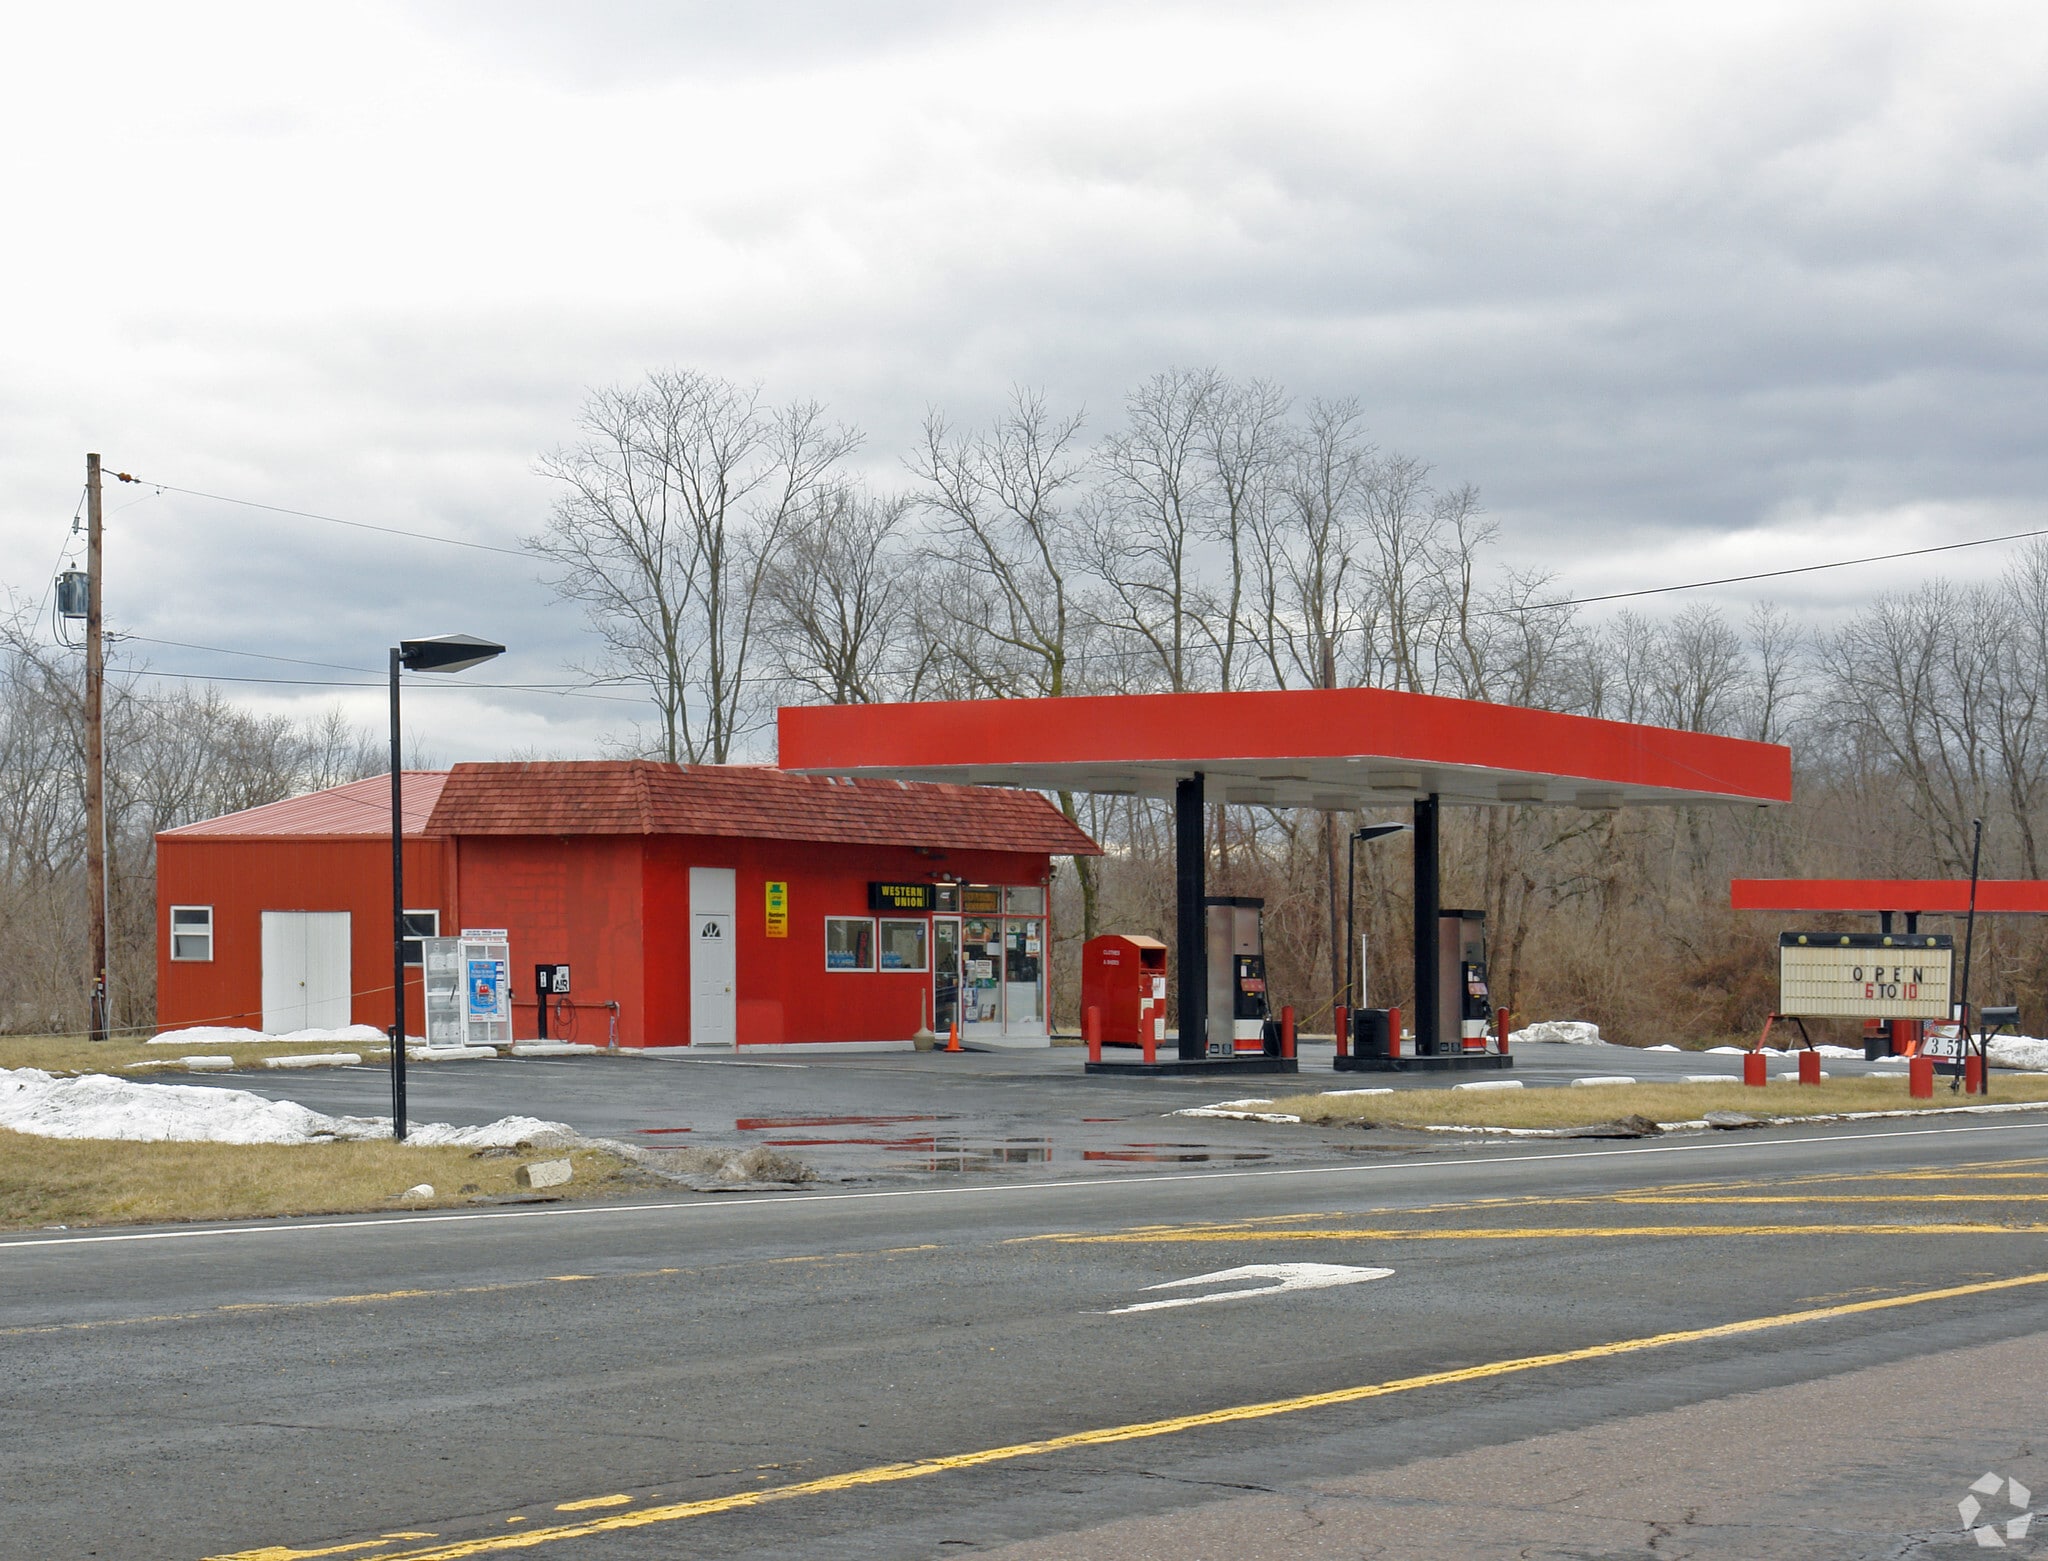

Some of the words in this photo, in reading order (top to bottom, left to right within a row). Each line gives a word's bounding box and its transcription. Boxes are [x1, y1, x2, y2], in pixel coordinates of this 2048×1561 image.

[881, 886, 923, 897] WESTERN
[894, 896, 923, 907] UNION
[1853, 966, 1923, 984] OPEN
[555, 979, 568, 991] AIR
[1865, 983, 1874, 999] 6
[1878, 984, 1897, 999] TO
[1903, 983, 1918, 1000] 10
